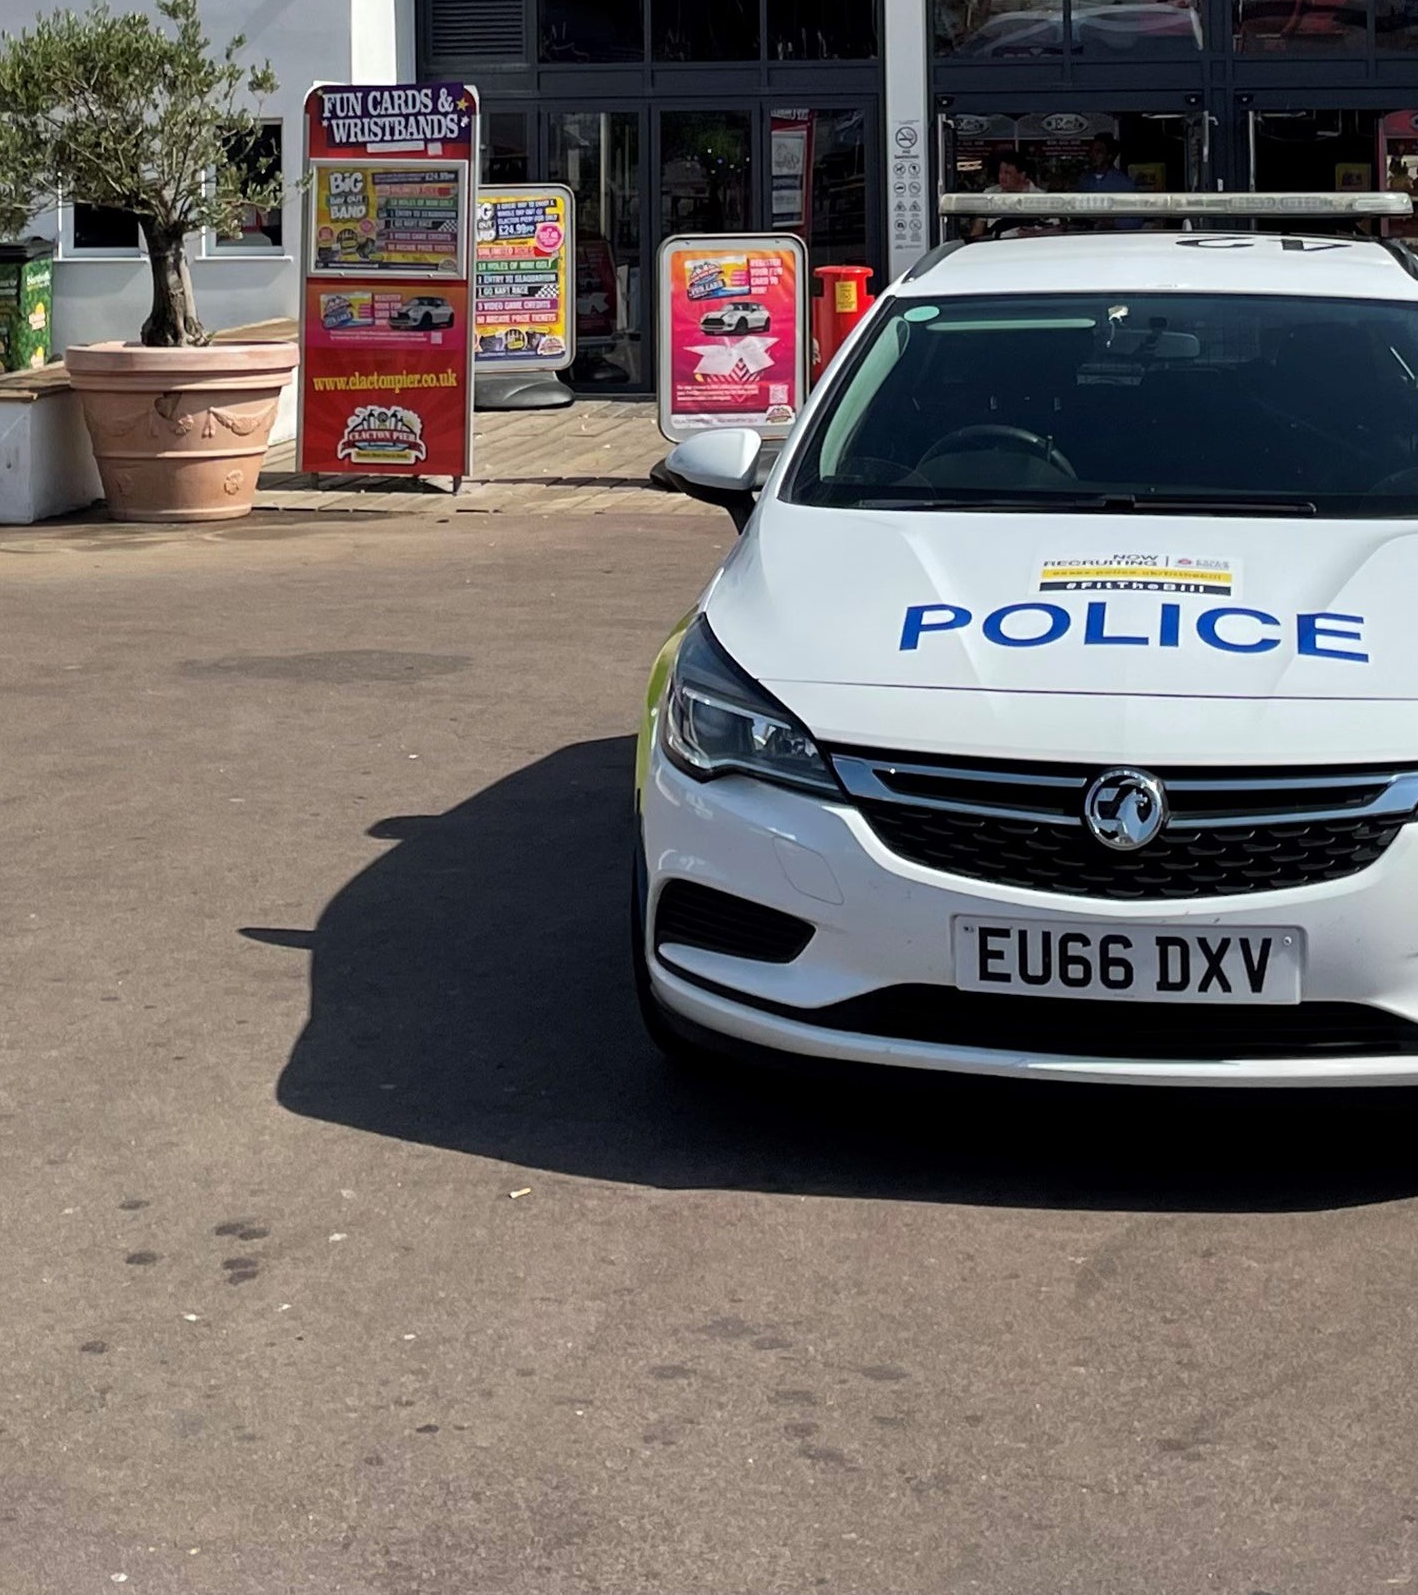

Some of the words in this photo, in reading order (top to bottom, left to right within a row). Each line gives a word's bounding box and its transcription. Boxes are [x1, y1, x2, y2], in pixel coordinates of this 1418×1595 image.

[321, 92, 363, 118] FUN
[367, 88, 433, 115] CARDS
[437, 87, 455, 113] &
[332, 114, 459, 144] WRISTBANDS
[330, 205, 367, 219] BAND
[312, 368, 458, 394] www.clactonpier.co.uk
[349, 431, 390, 442] CLACTON
[392, 430, 417, 442] PIER
[1043, 558, 1158, 567] RECRUITING
[1112, 553, 1159, 561] NOW
[1065, 581, 1205, 594] #FitTheBill
[898, 601, 1370, 664] POLICE
[978, 926, 1134, 990] EU66
[1155, 935, 1273, 994] DXV
